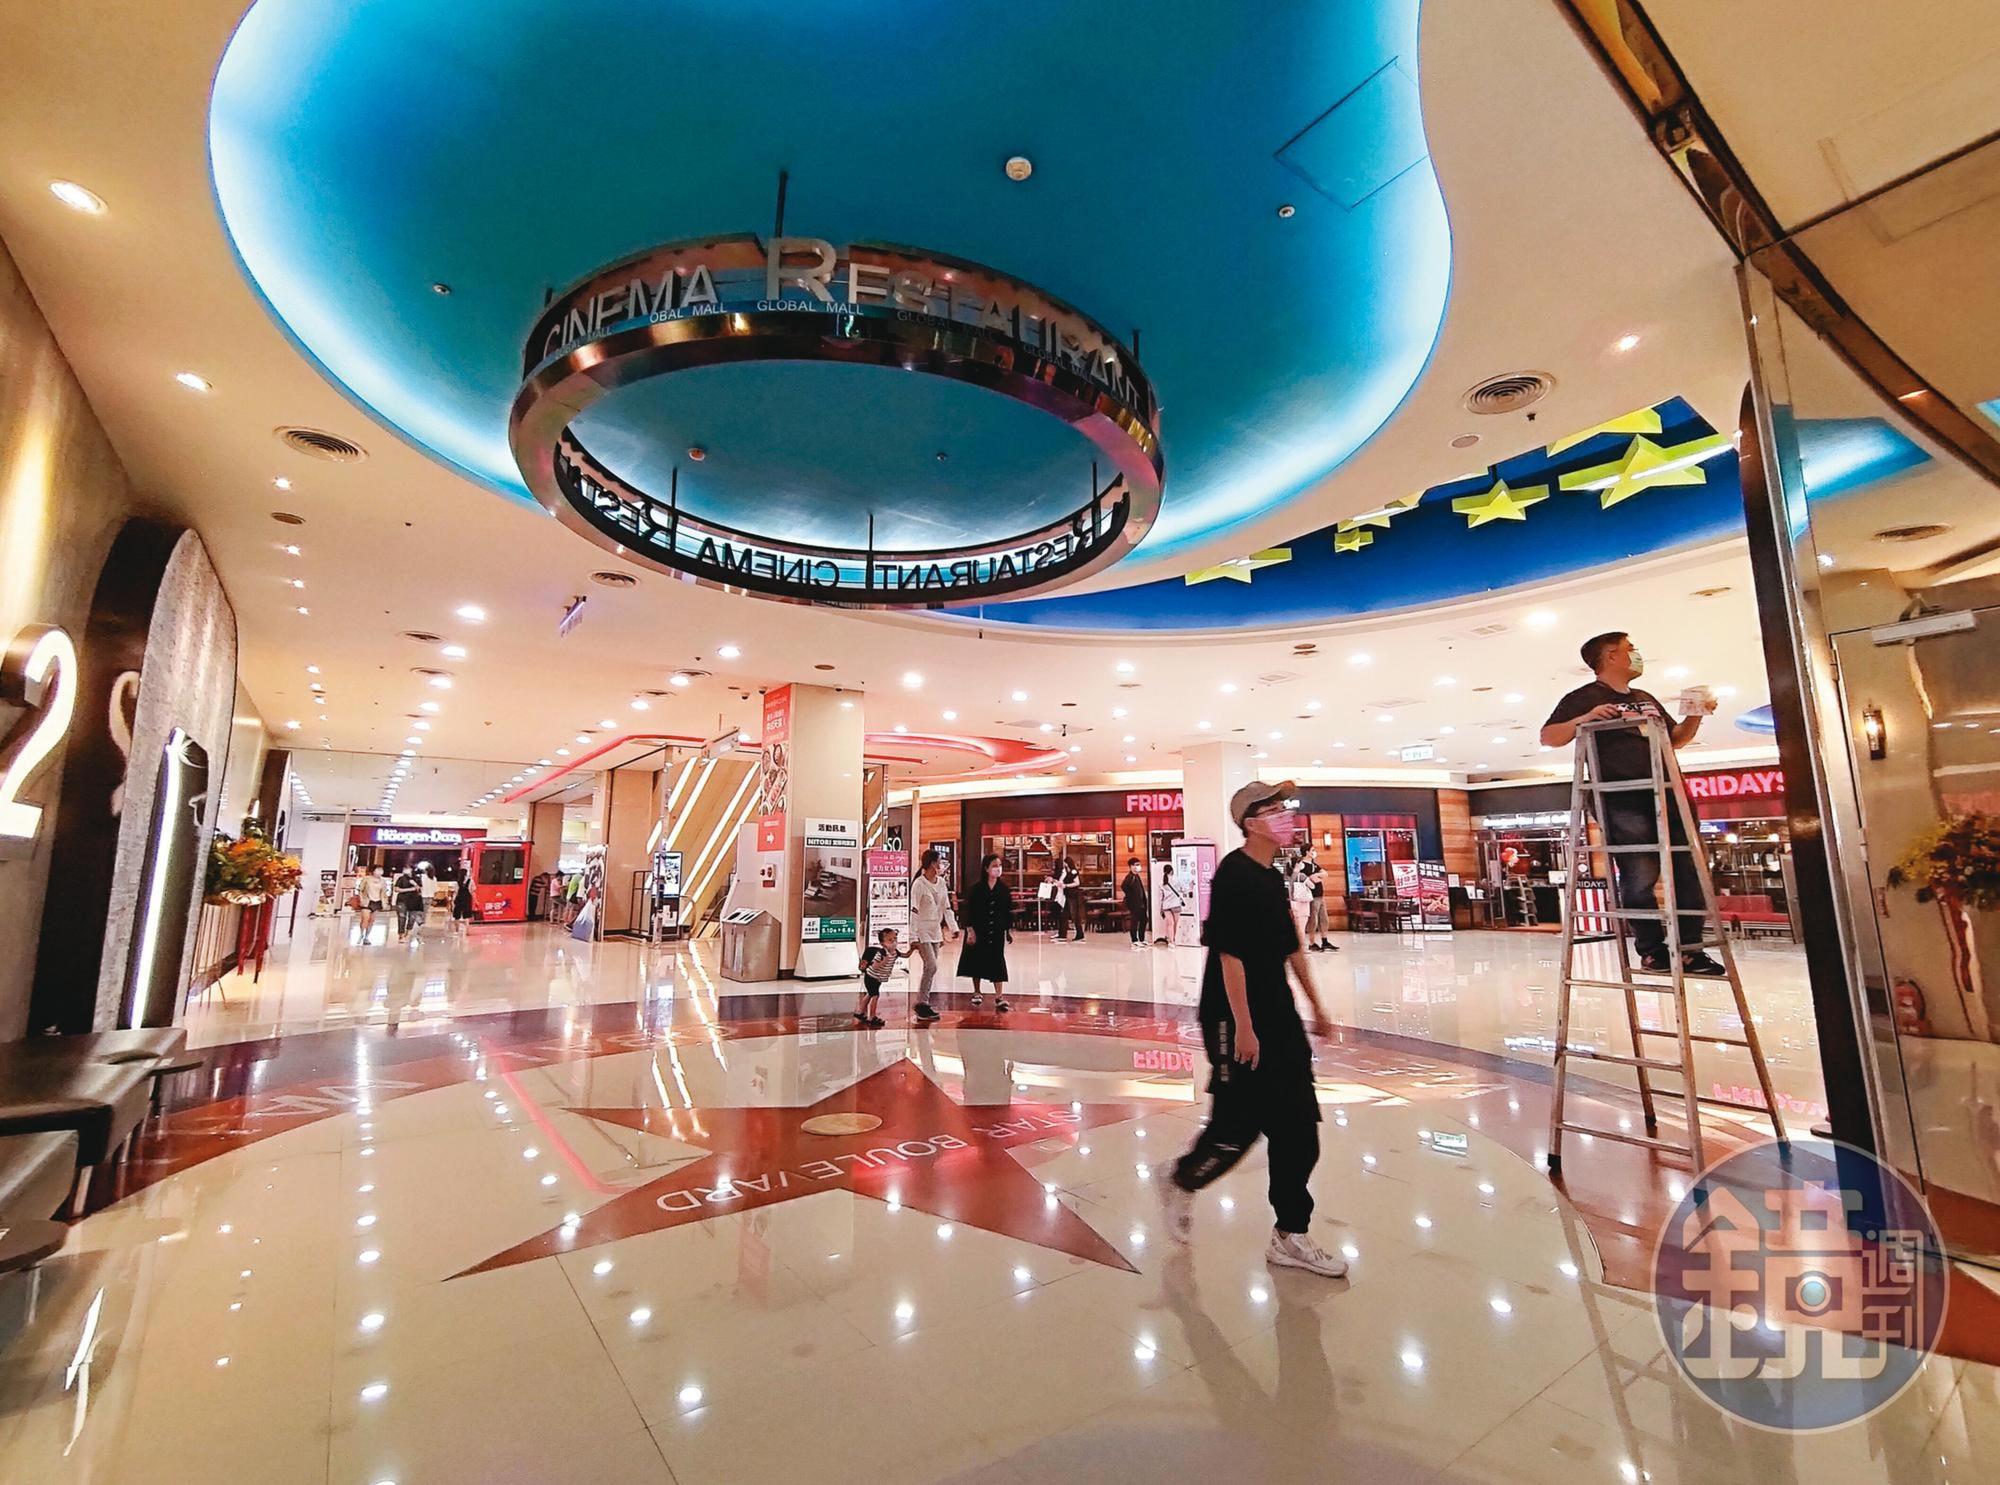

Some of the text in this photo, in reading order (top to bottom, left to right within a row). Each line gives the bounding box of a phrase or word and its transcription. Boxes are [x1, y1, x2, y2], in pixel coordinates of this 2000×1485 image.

[543, 264, 719, 362] CINEMA
[692, 303, 728, 316] MALL
[757, 300, 864, 316] GLOBAL MALL
[1686, 771, 1785, 798] RIDAYS
[807, 838, 832, 847] NITORI
[971, 1109, 1083, 1140] STAR
[656, 1133, 968, 1212] BOULEVARD
